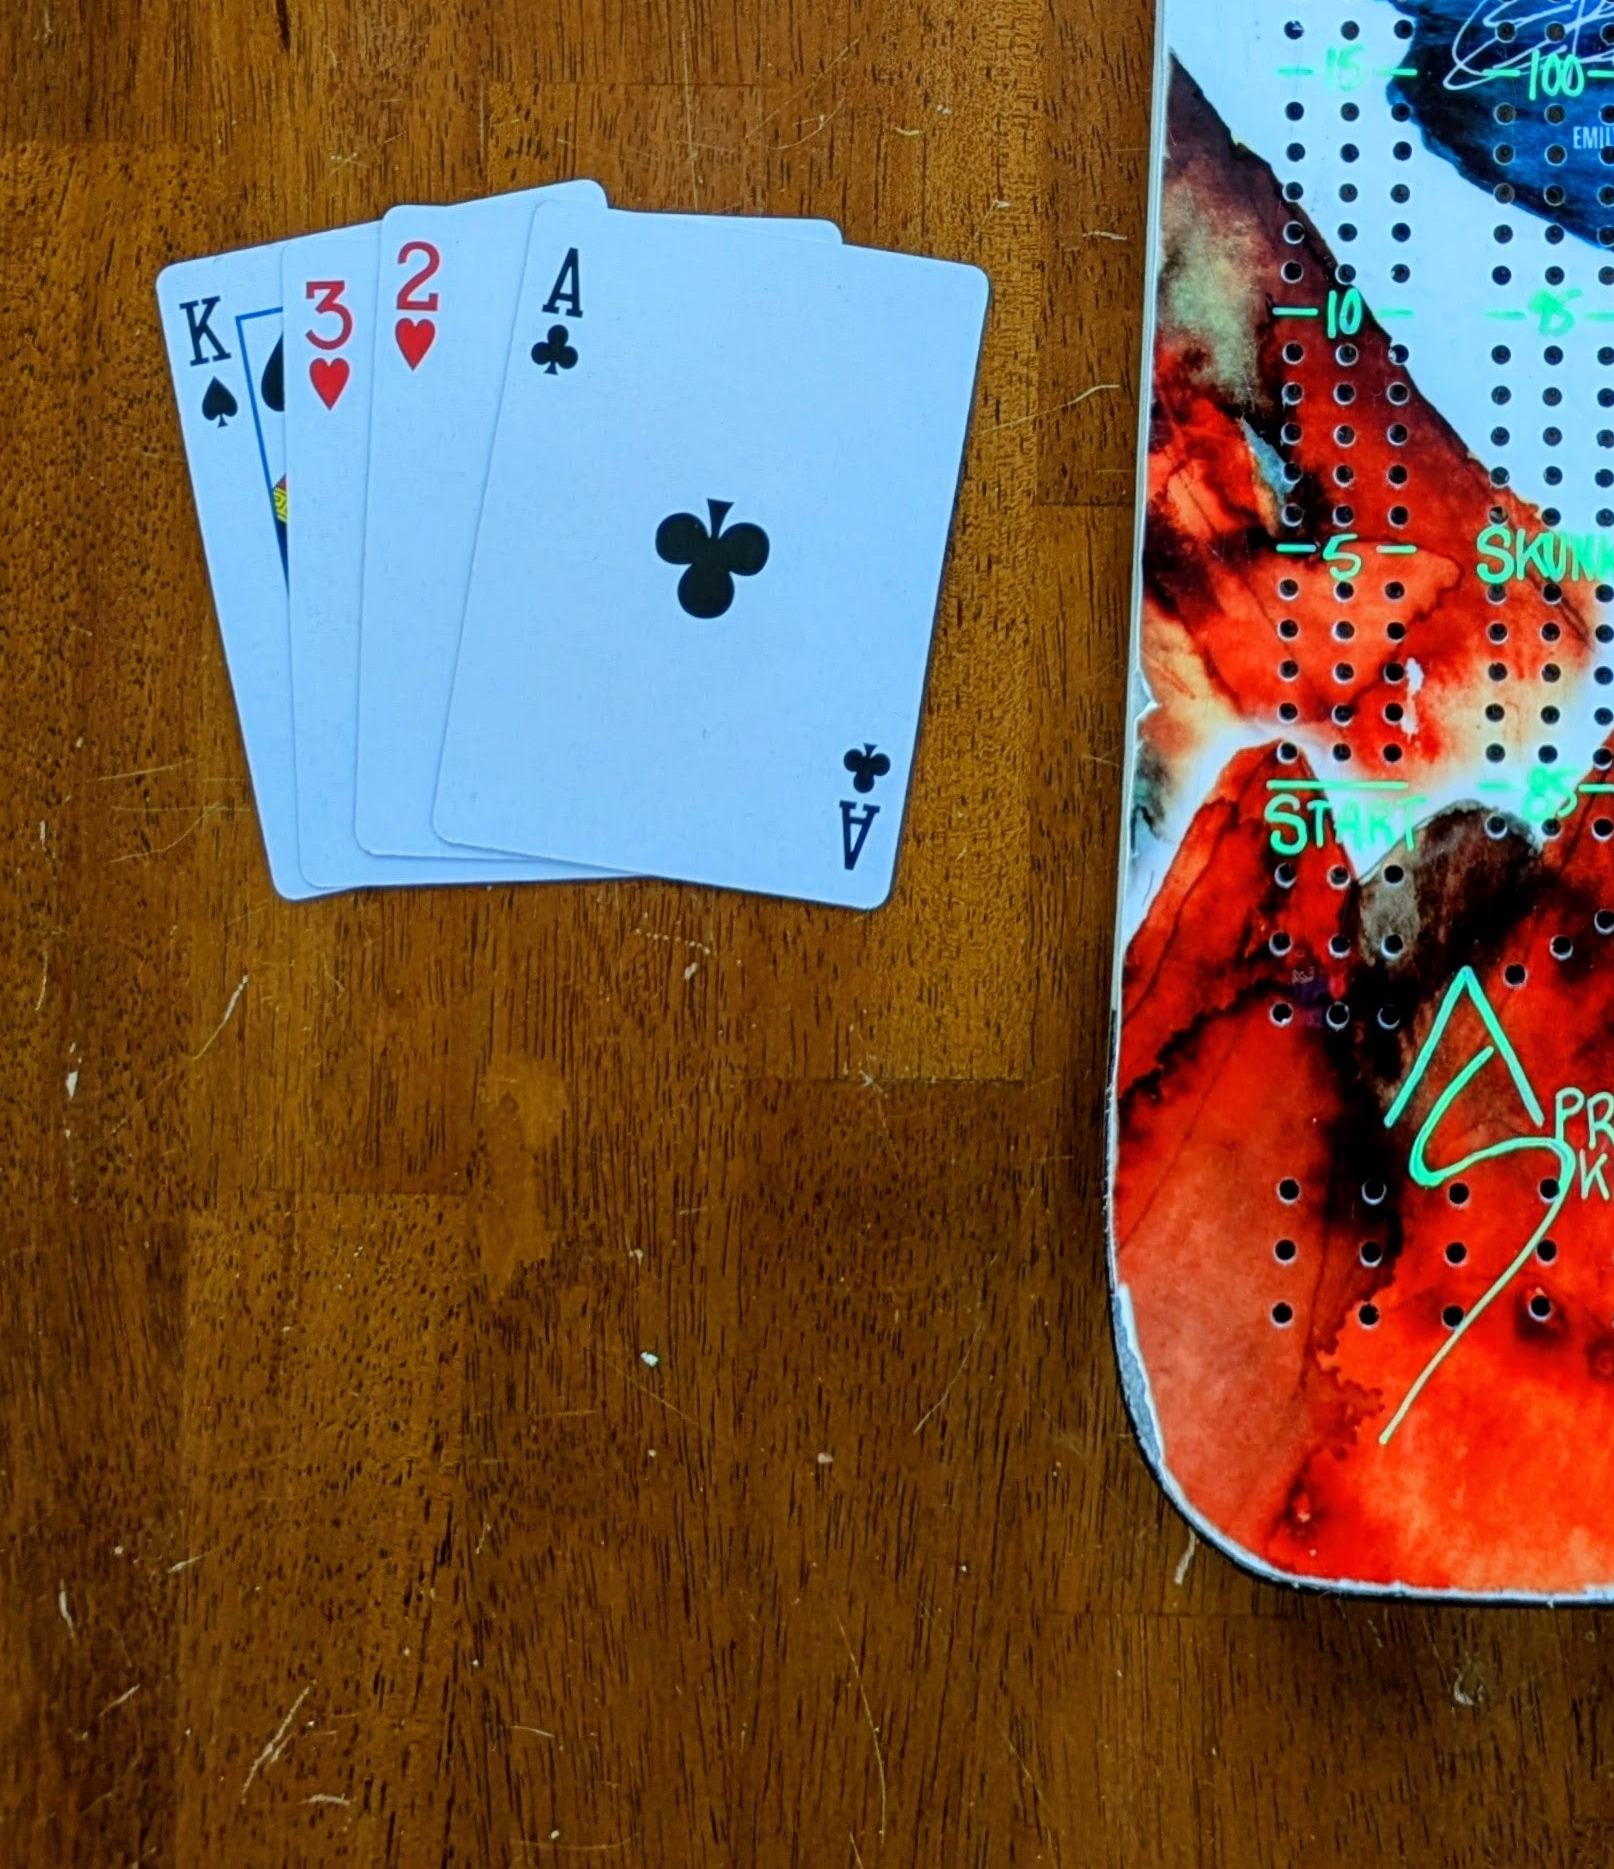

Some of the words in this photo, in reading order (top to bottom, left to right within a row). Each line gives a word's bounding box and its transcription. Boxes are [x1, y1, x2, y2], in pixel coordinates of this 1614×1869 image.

[1325, 45, 1366, 92] 15
[1528, 49, 1585, 101] 100
[396, 240, 441, 312] 2
[541, 246, 584, 319] A
[179, 295, 232, 367] K
[305, 279, 354, 351] 3
[1326, 287, 1363, 340] 10
[1322, 533, 1362, 582] 5
[1264, 793, 1428, 856] START
[1521, 766, 1580, 822] 85
[839, 799, 882, 871] A
